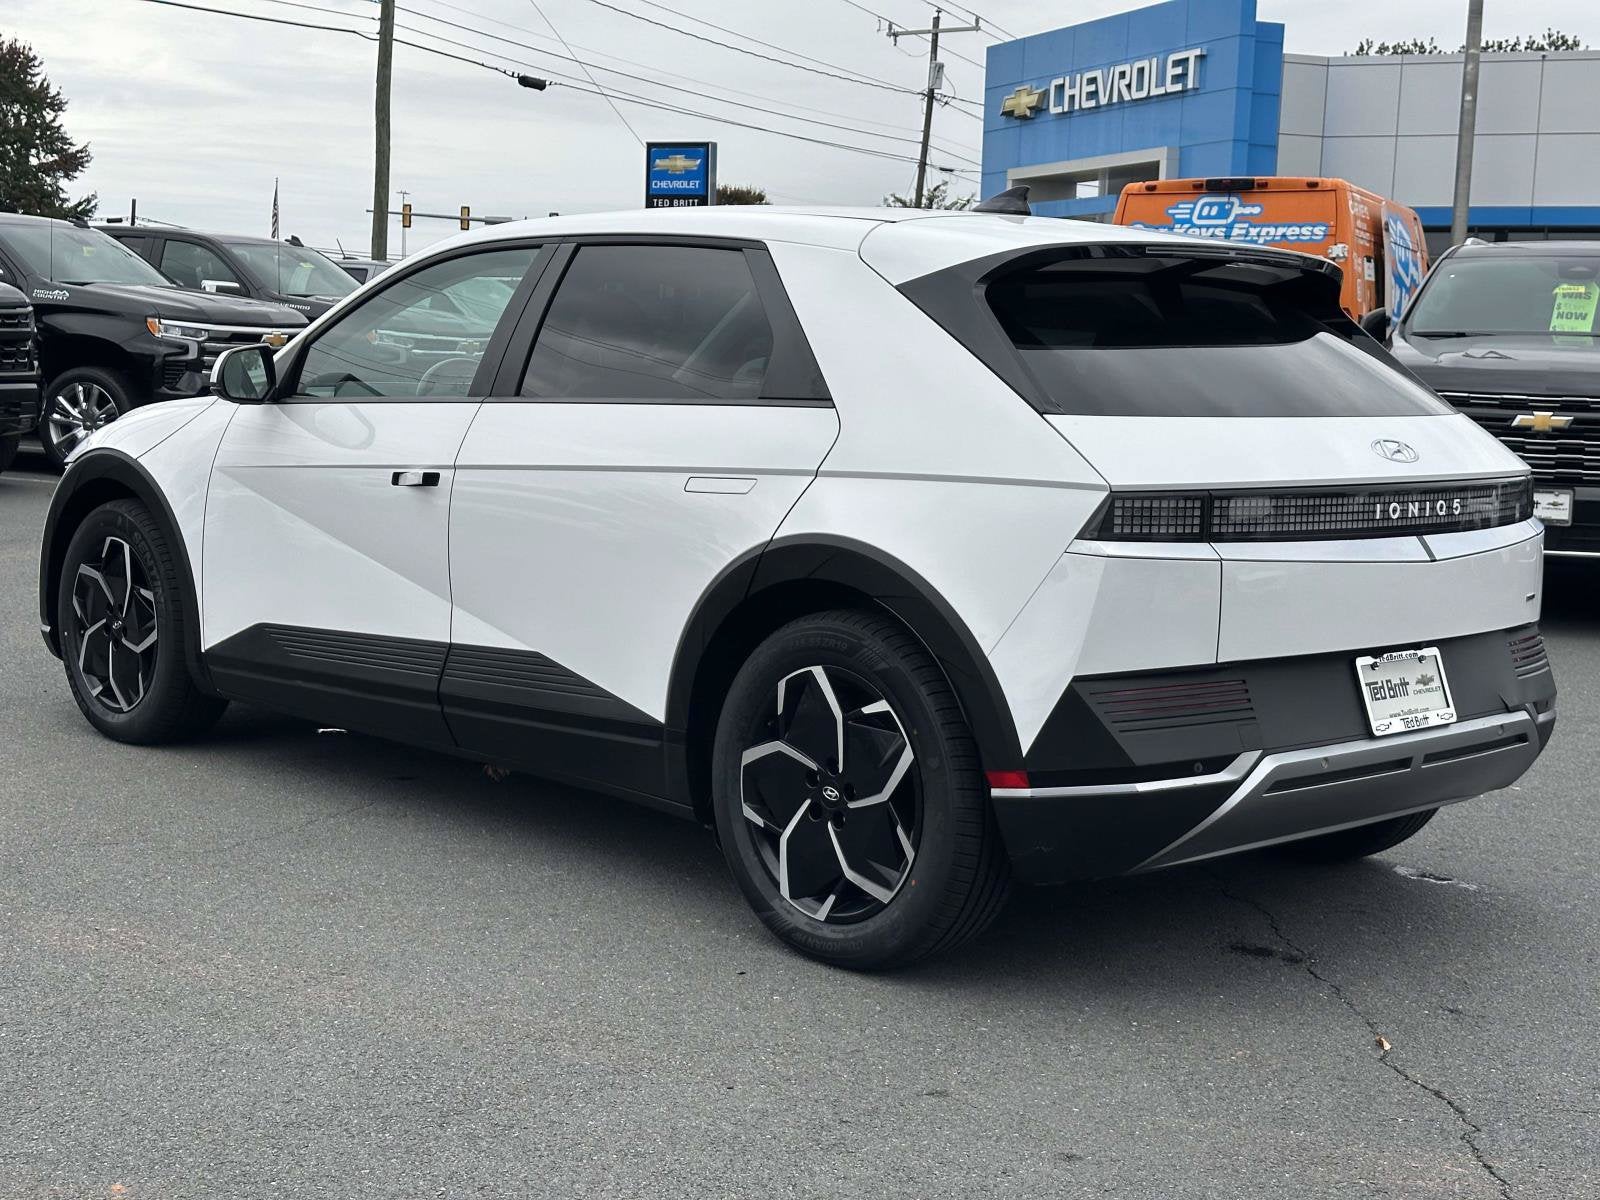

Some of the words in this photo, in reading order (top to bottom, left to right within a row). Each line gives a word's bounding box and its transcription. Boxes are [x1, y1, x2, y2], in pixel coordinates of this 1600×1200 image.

[1049, 47, 1206, 114] CHEVROLET
[652, 180, 700, 189] CHEVROLET
[653, 198, 670, 207] TED
[673, 198, 699, 207] BRITT
[1229, 222, 1327, 244] Express
[1556, 311, 1588, 321] NOW
[1412, 685, 1442, 696] CHEVROLET
